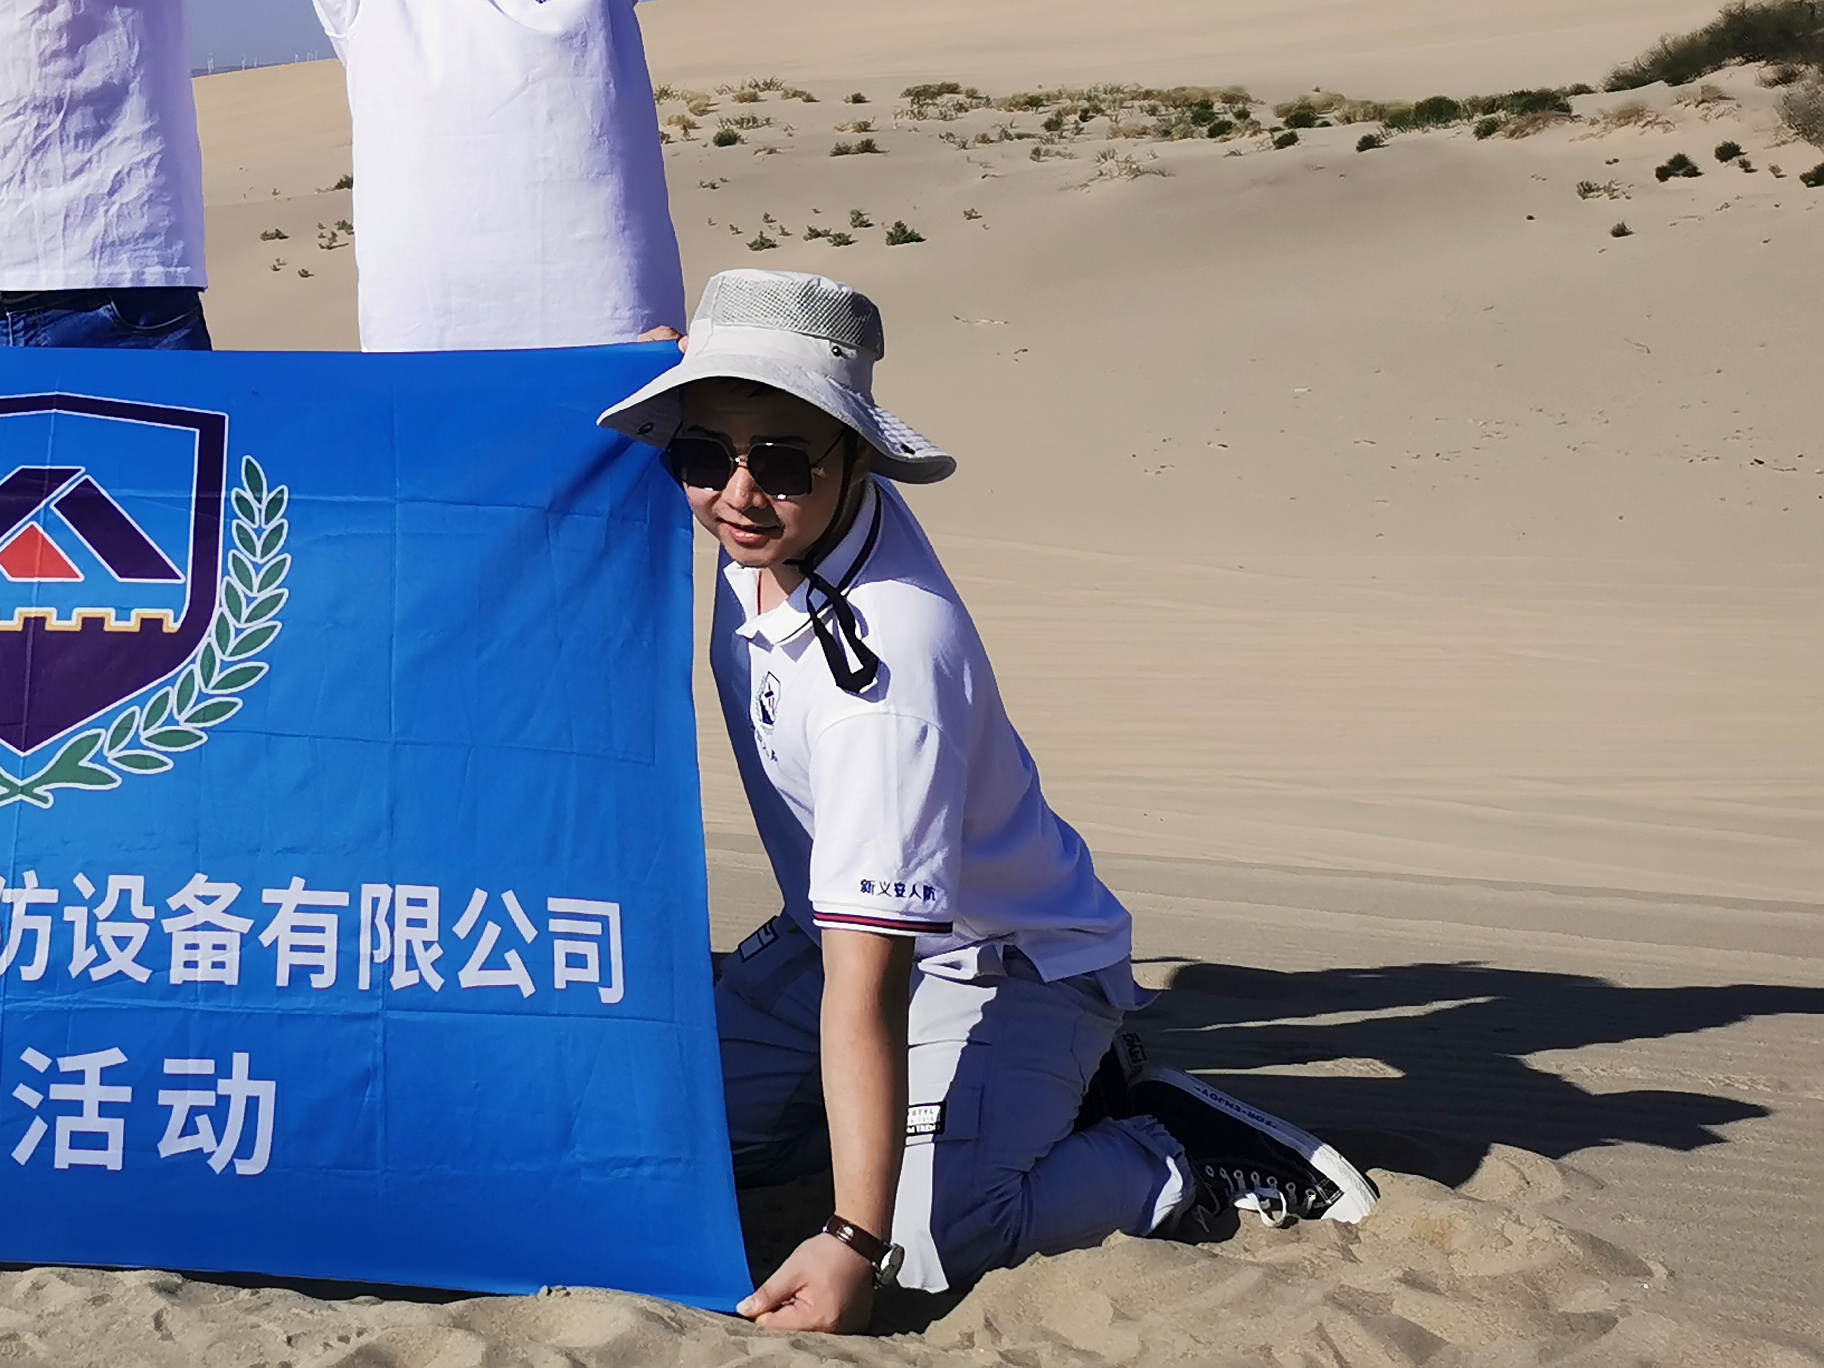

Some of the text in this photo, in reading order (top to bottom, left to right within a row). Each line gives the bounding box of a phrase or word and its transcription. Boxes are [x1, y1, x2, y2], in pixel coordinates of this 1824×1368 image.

[860, 878, 937, 902] 新义安人防
